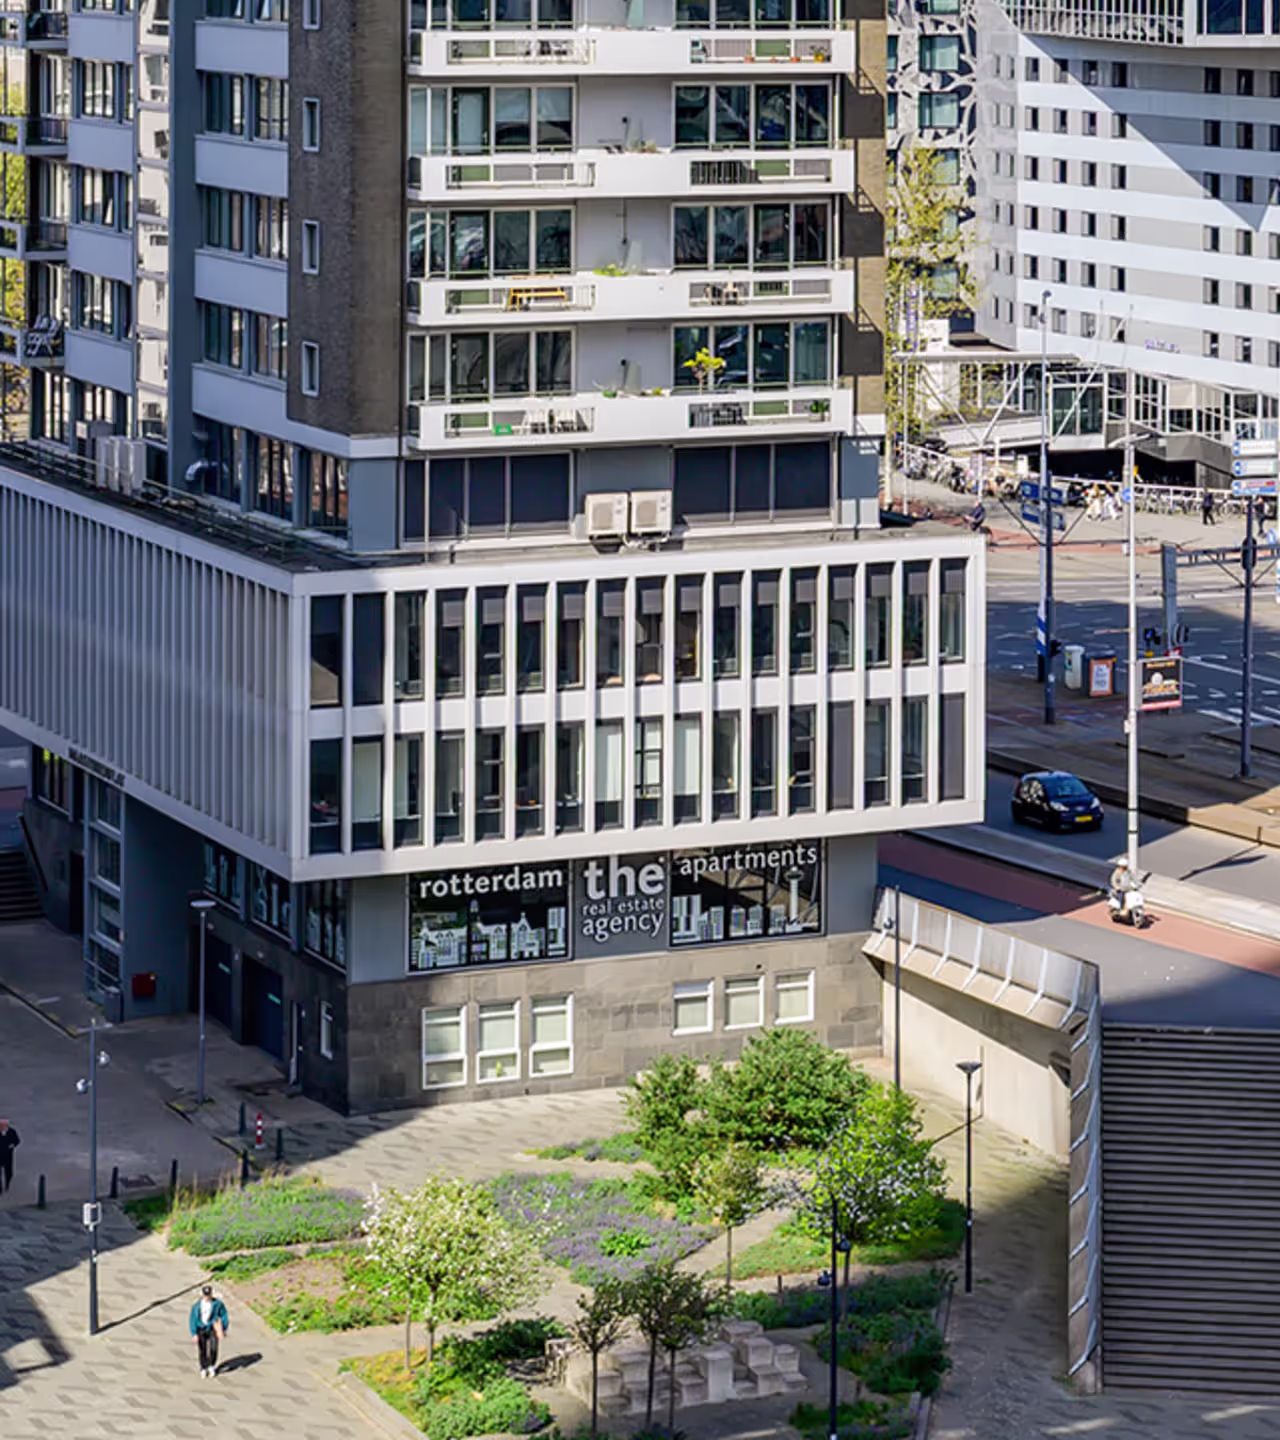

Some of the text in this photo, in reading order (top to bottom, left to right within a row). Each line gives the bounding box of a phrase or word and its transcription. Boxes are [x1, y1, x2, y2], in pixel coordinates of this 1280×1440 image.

[583, 855, 665, 900] the
[680, 845, 817, 882] apartments
[420, 865, 563, 898] rotterdam
[582, 897, 664, 916] real estate
[582, 912, 664, 943] agency
